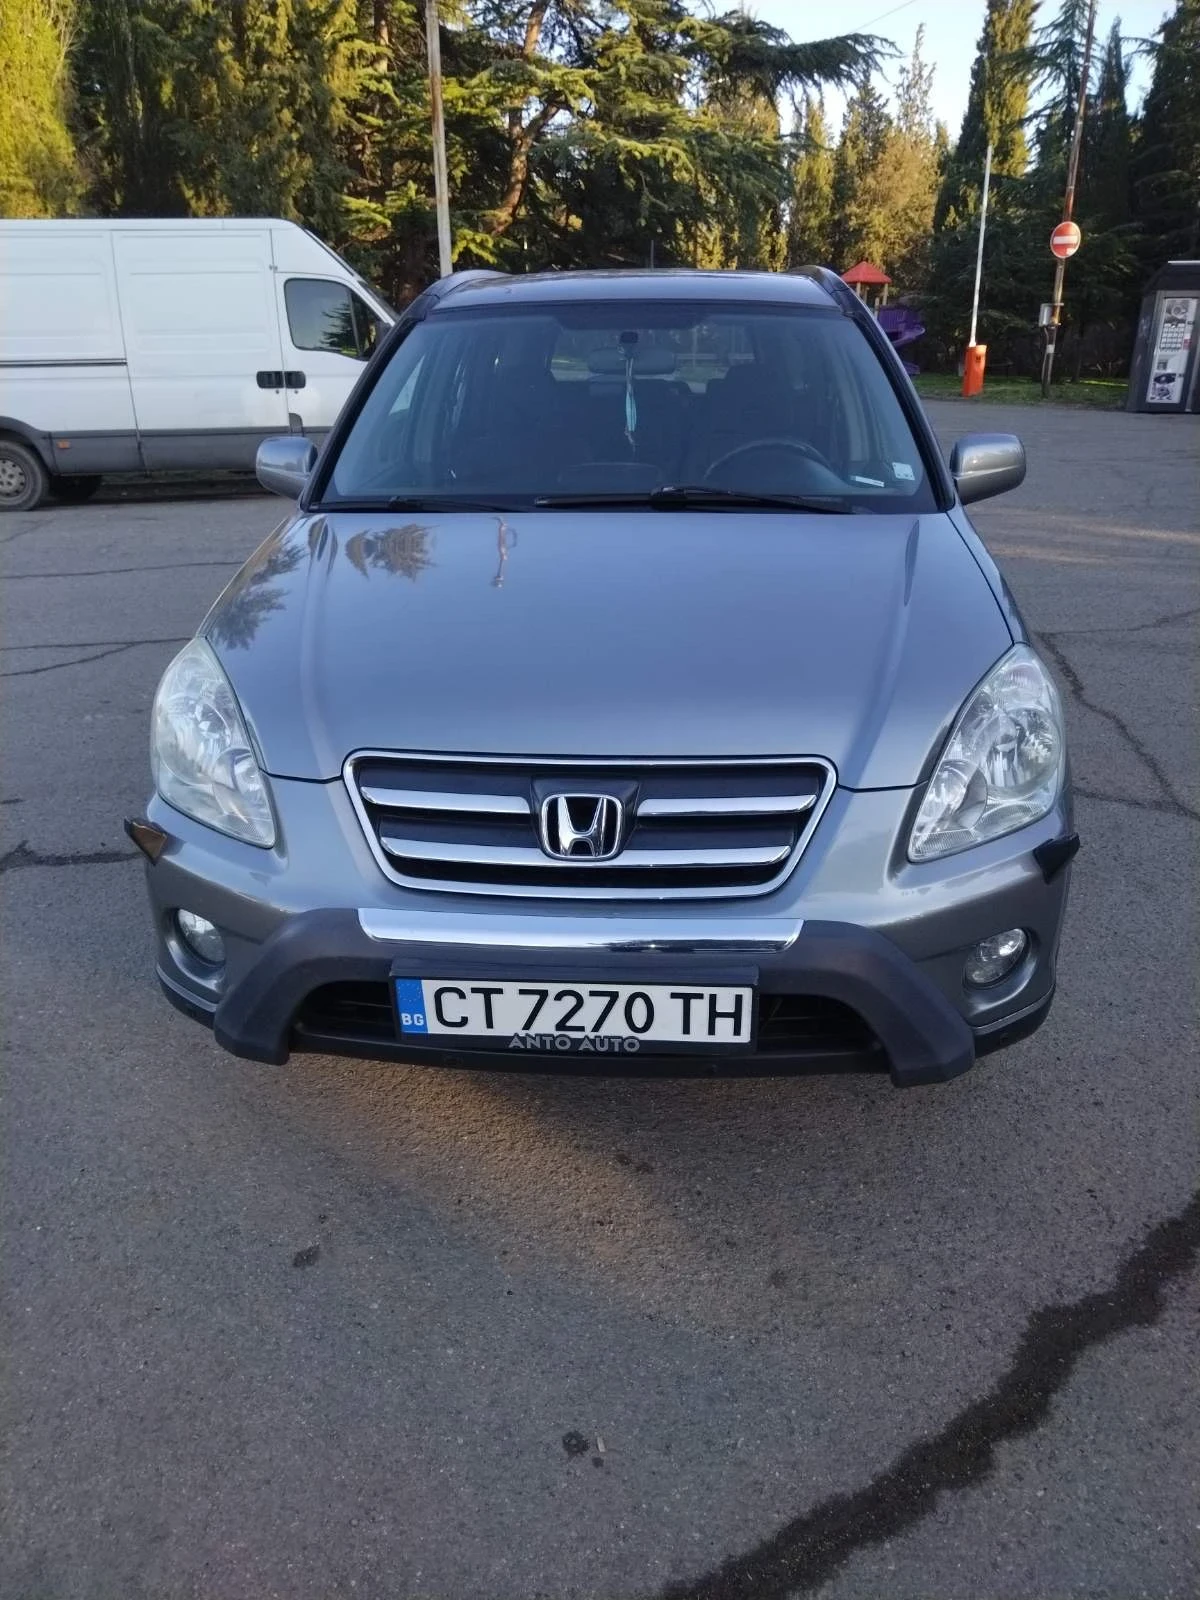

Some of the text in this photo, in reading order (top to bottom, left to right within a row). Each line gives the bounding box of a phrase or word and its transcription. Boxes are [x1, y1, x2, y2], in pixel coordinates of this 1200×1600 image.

[401, 1012, 424, 1026] BG
[434, 986, 743, 1036] CT 7270 TH
[508, 1033, 640, 1053] ANTO AUTO
